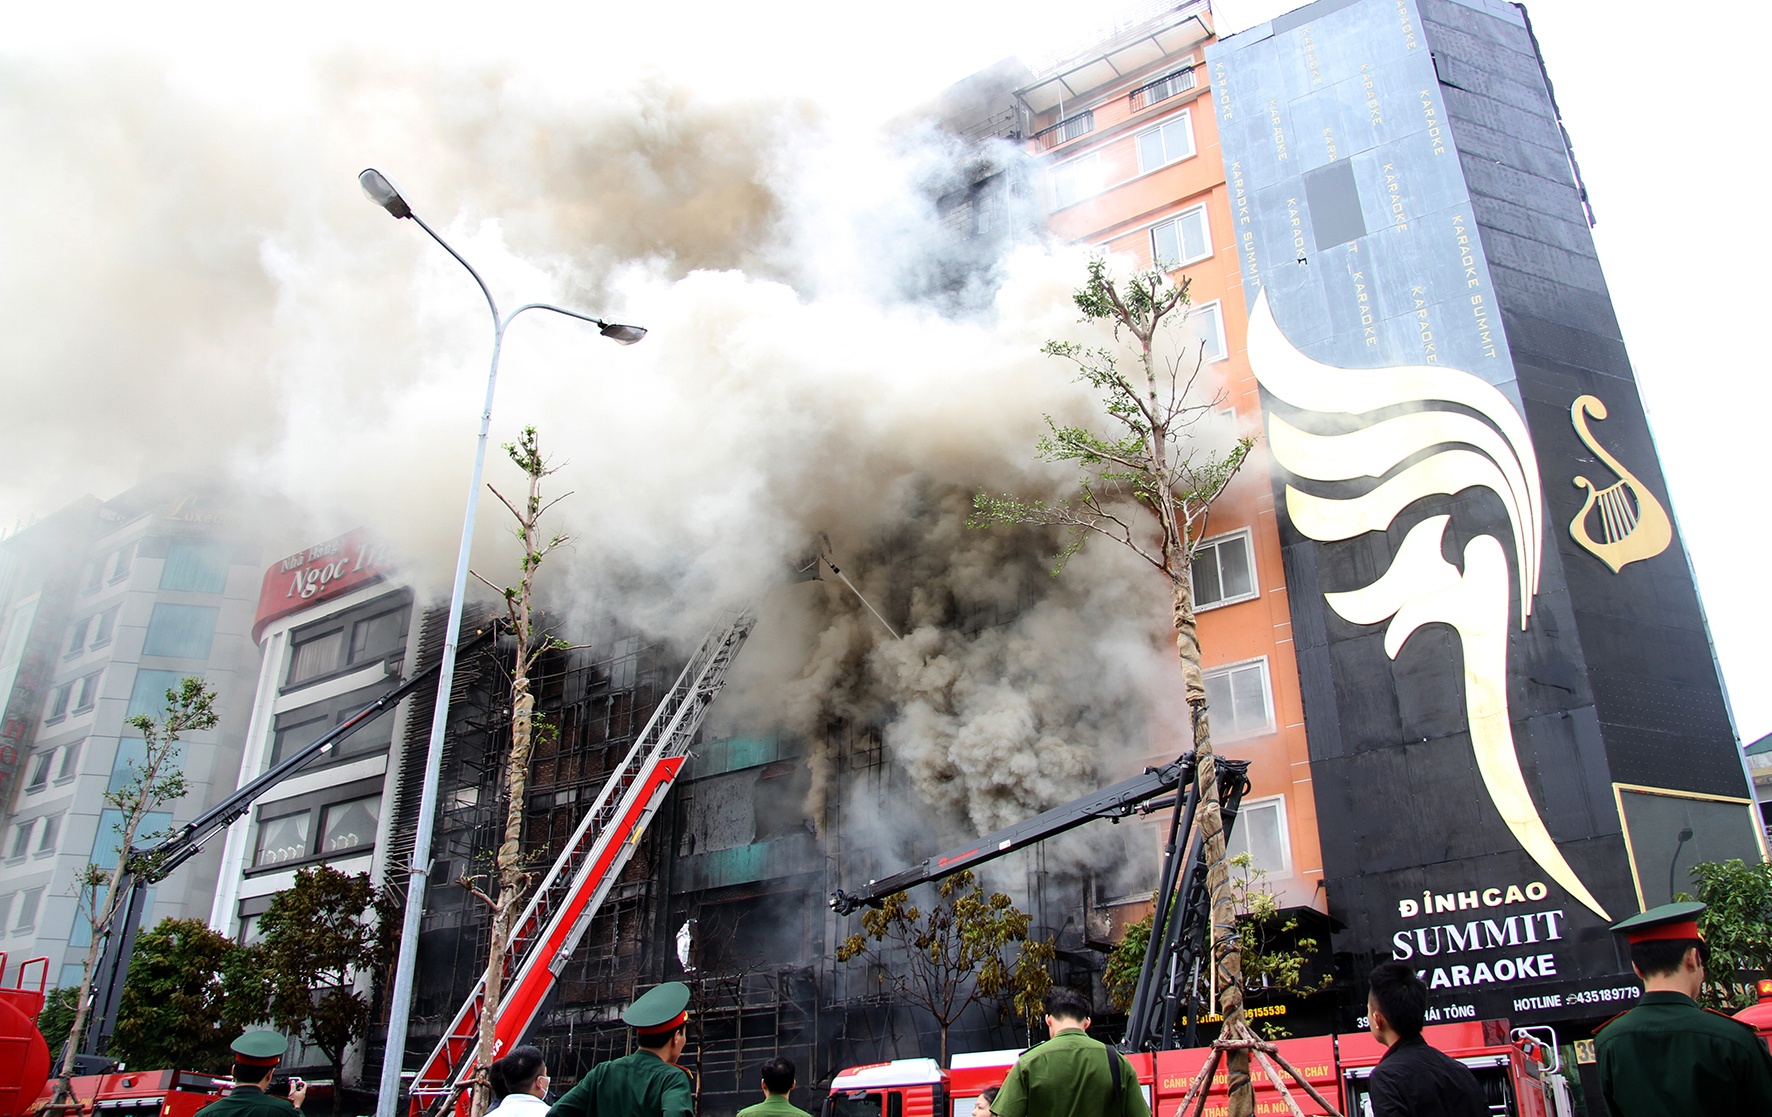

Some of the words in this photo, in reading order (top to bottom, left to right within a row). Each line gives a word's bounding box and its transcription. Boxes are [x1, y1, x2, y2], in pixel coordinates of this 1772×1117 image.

[1302, 27, 1322, 86] KARAOKE
[1215, 61, 1233, 121] KARAOKE
[1360, 62, 1383, 127] KARAOKE
[1269, 99, 1288, 162] KARAOKE
[1419, 89, 1445, 157] KARAOKE
[1231, 161, 1250, 226] KARAOKE
[1243, 231, 1261, 287] SUMMIT
[1383, 162, 1408, 234] KARAOKE
[1353, 271, 1377, 348] KARAOKE
[1452, 214, 1480, 289] KARAOKE
[1471, 294, 1497, 359] SUMMIT
[1411, 285, 1438, 365] KARAOKE
[286, 557, 350, 599] Ngọc
[1391, 909, 1564, 962] SUMMIT
[1416, 953, 1558, 990] ARAOKE
[1443, 1003, 1476, 1020] TÔNG
[1513, 994, 1563, 1012] HOTLINE
[1163, 1075, 1187, 1089] CẢNH
[1304, 1063, 1329, 1078] CHÁY
[1256, 1101, 1271, 1115] HÀ
